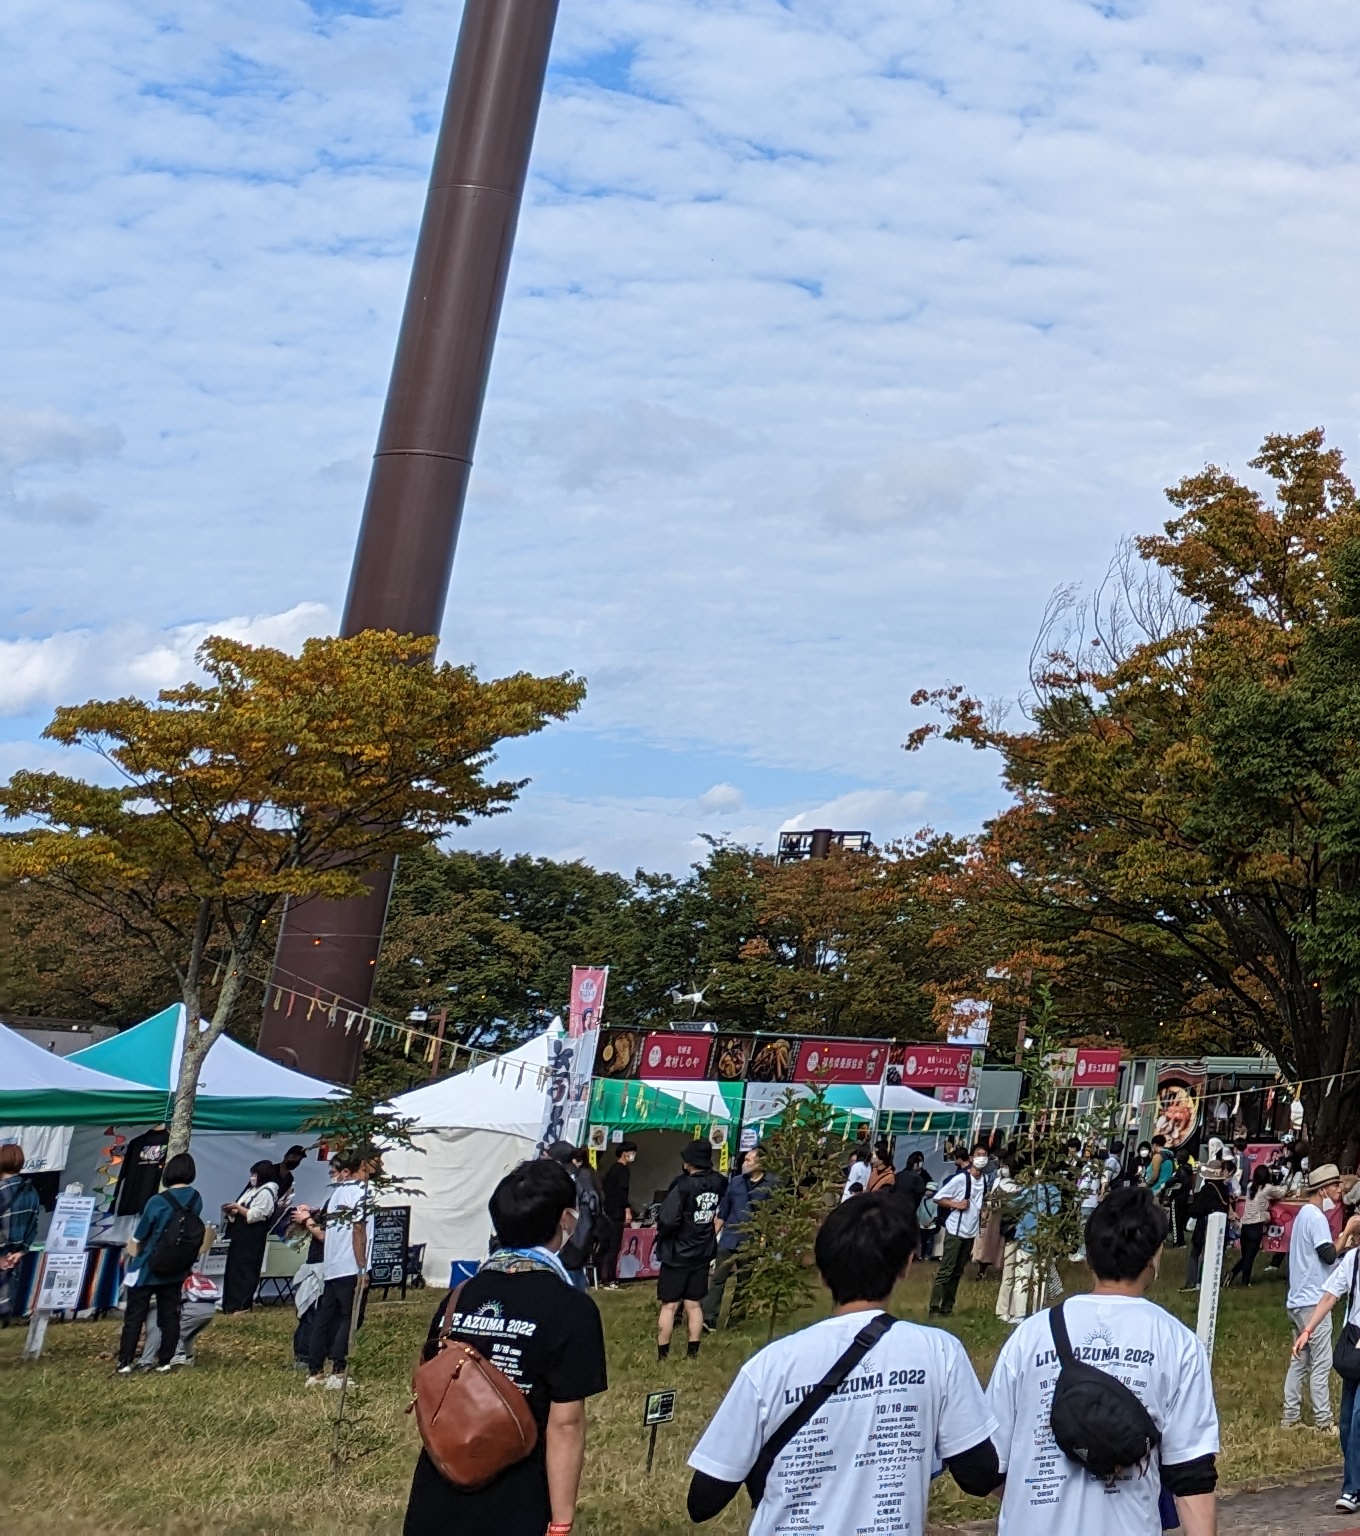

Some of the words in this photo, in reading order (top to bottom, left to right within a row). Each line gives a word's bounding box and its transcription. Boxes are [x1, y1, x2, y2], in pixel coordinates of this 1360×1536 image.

[462, 1315, 505, 1332] AZUMA
[506, 1319, 536, 1336] 2022
[1036, 1349, 1057, 1367] LIV
[1073, 1347, 1120, 1361] AZUMA
[888, 1370, 926, 1386] 2022
[877, 1473, 906, 1481] ユニコーン
